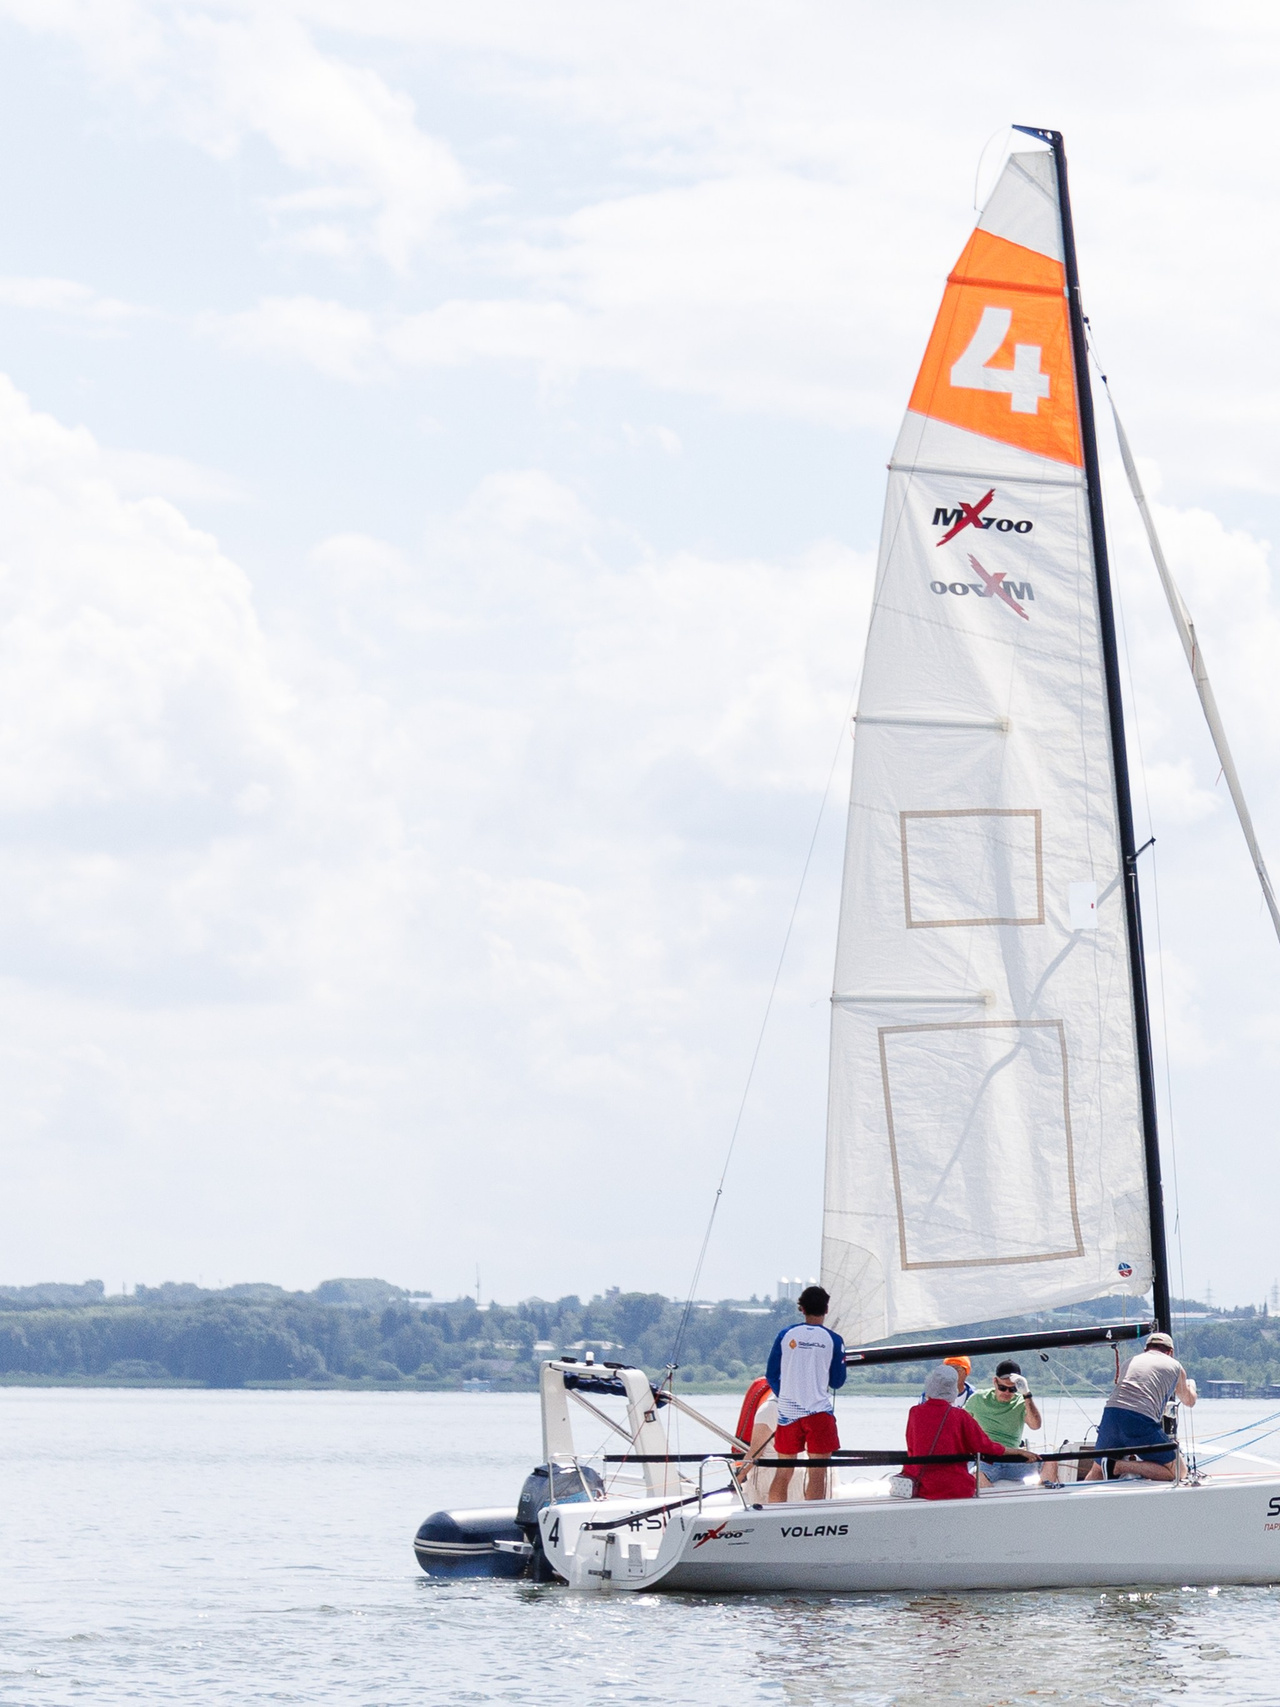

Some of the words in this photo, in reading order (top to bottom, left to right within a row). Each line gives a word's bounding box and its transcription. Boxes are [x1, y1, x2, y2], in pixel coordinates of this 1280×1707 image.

[950, 306, 1050, 415] 4
[931, 488, 1033, 547] MX700
[1105, 1329, 1113, 1340] 4
[548, 1517, 560, 1548] 4
[692, 1521, 743, 1549] MX700
[781, 1525, 849, 1538] VOLANS
